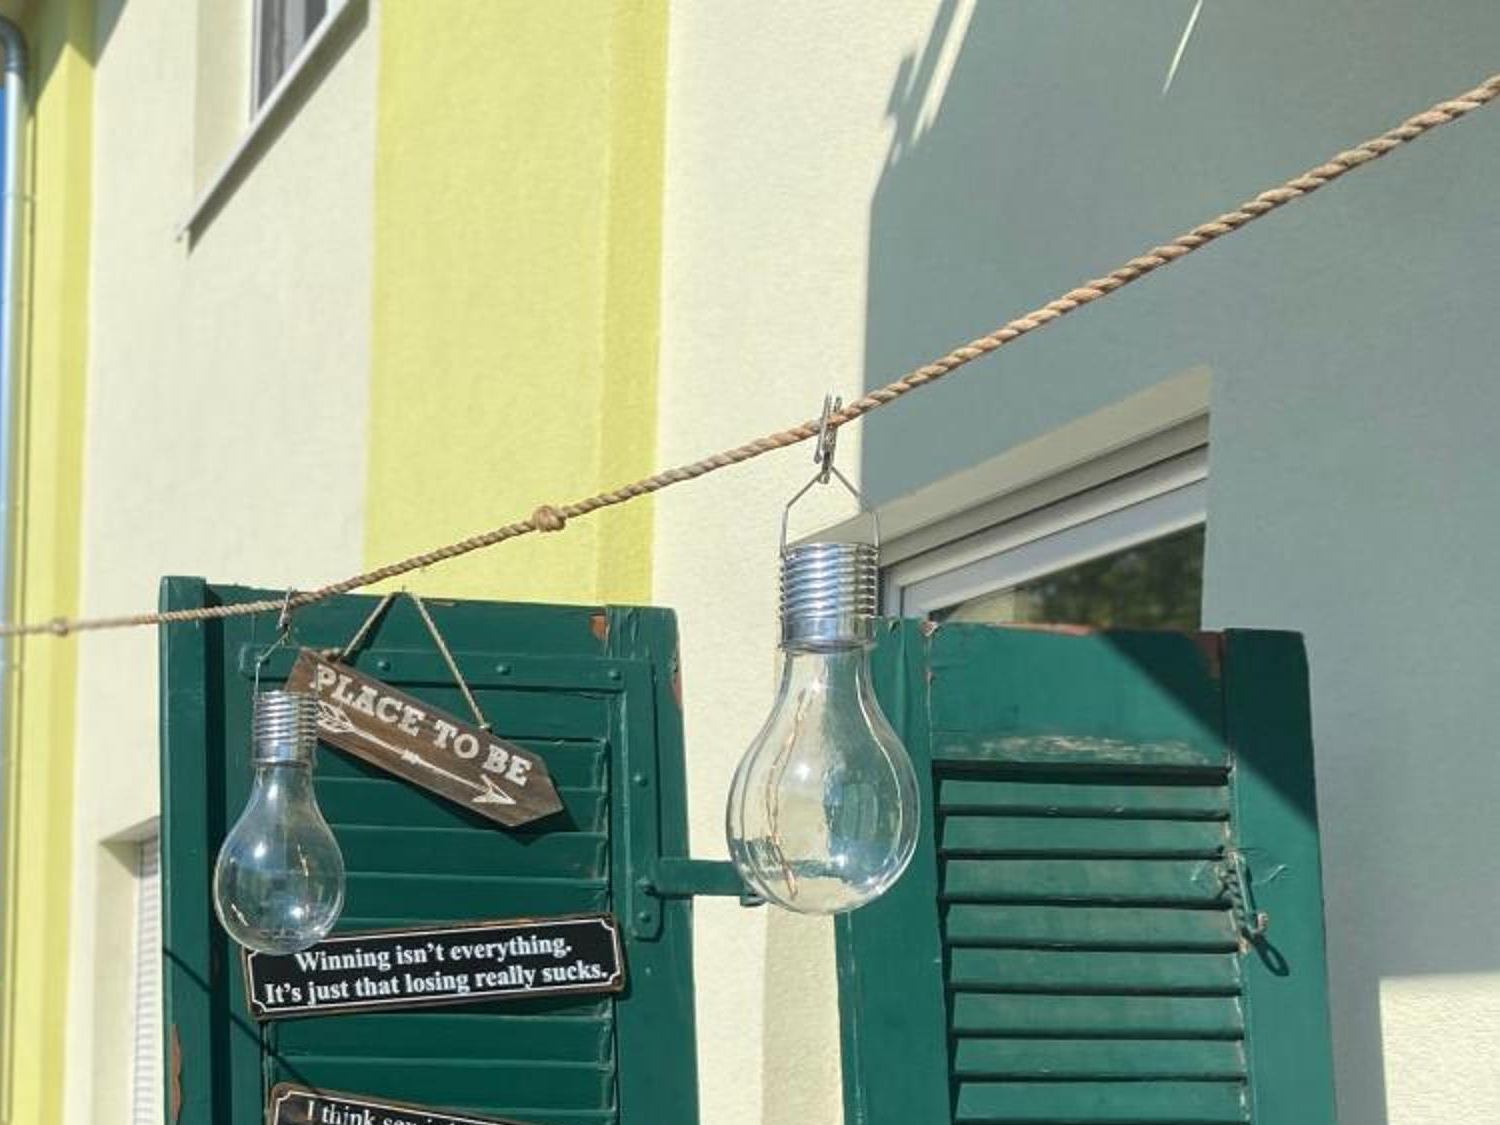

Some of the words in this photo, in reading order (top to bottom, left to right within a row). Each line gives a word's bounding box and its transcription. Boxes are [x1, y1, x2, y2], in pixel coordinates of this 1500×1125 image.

[309, 663, 426, 737] PLACE
[433, 719, 479, 760] TO
[482, 744, 533, 787] BE
[295, 949, 391, 973] Winning
[396, 943, 444, 966] isn't
[449, 935, 572, 960] everything.
[264, 982, 301, 1005] It's
[306, 980, 350, 1006] just
[354, 975, 400, 997] that
[404, 967, 470, 994] losing
[474, 964, 536, 992] really
[542, 960, 608, 983] sucks.
